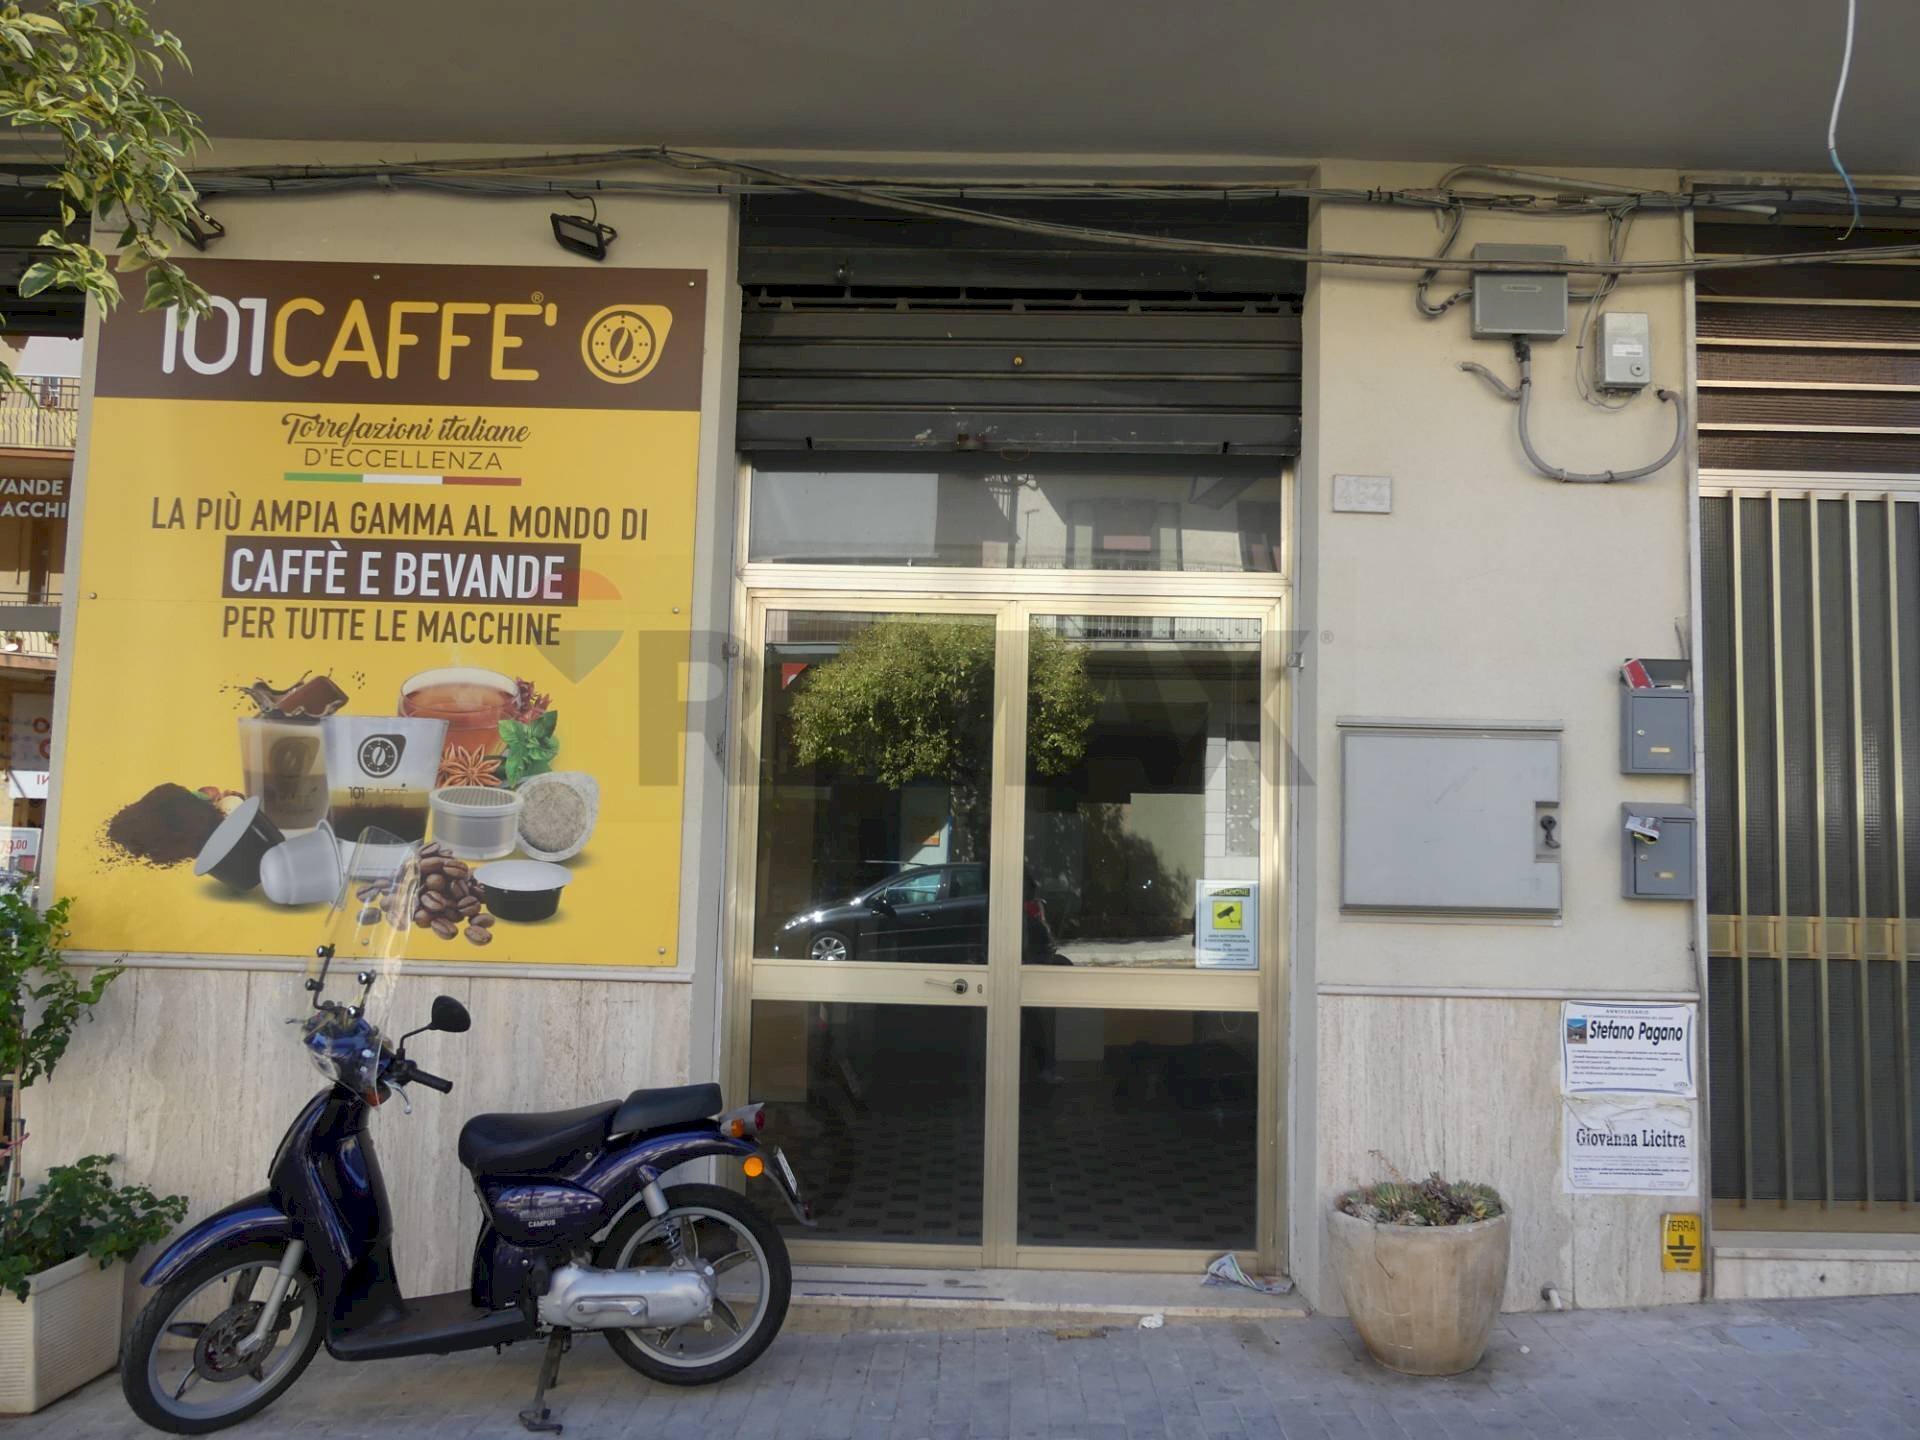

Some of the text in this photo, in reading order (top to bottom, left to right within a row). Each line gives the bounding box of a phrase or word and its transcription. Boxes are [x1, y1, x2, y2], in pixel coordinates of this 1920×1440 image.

[281, 412, 531, 447] Torrefazioni italiane
[304, 447, 502, 471] D'ECCELLENZA
[151, 490, 648, 541] LA PIÙ AMPIA GAMMA AL MONDO DI
[230, 540, 565, 600] CAFFÈ E BEVANDE
[222, 605, 562, 646] PER TUTTE LE MACCHINE
[1589, 1020, 1683, 1046] Stefano Pagano
[1576, 1128, 1686, 1148] Giovanna Licitra
[528, 1219, 556, 1228] CAMPUS
